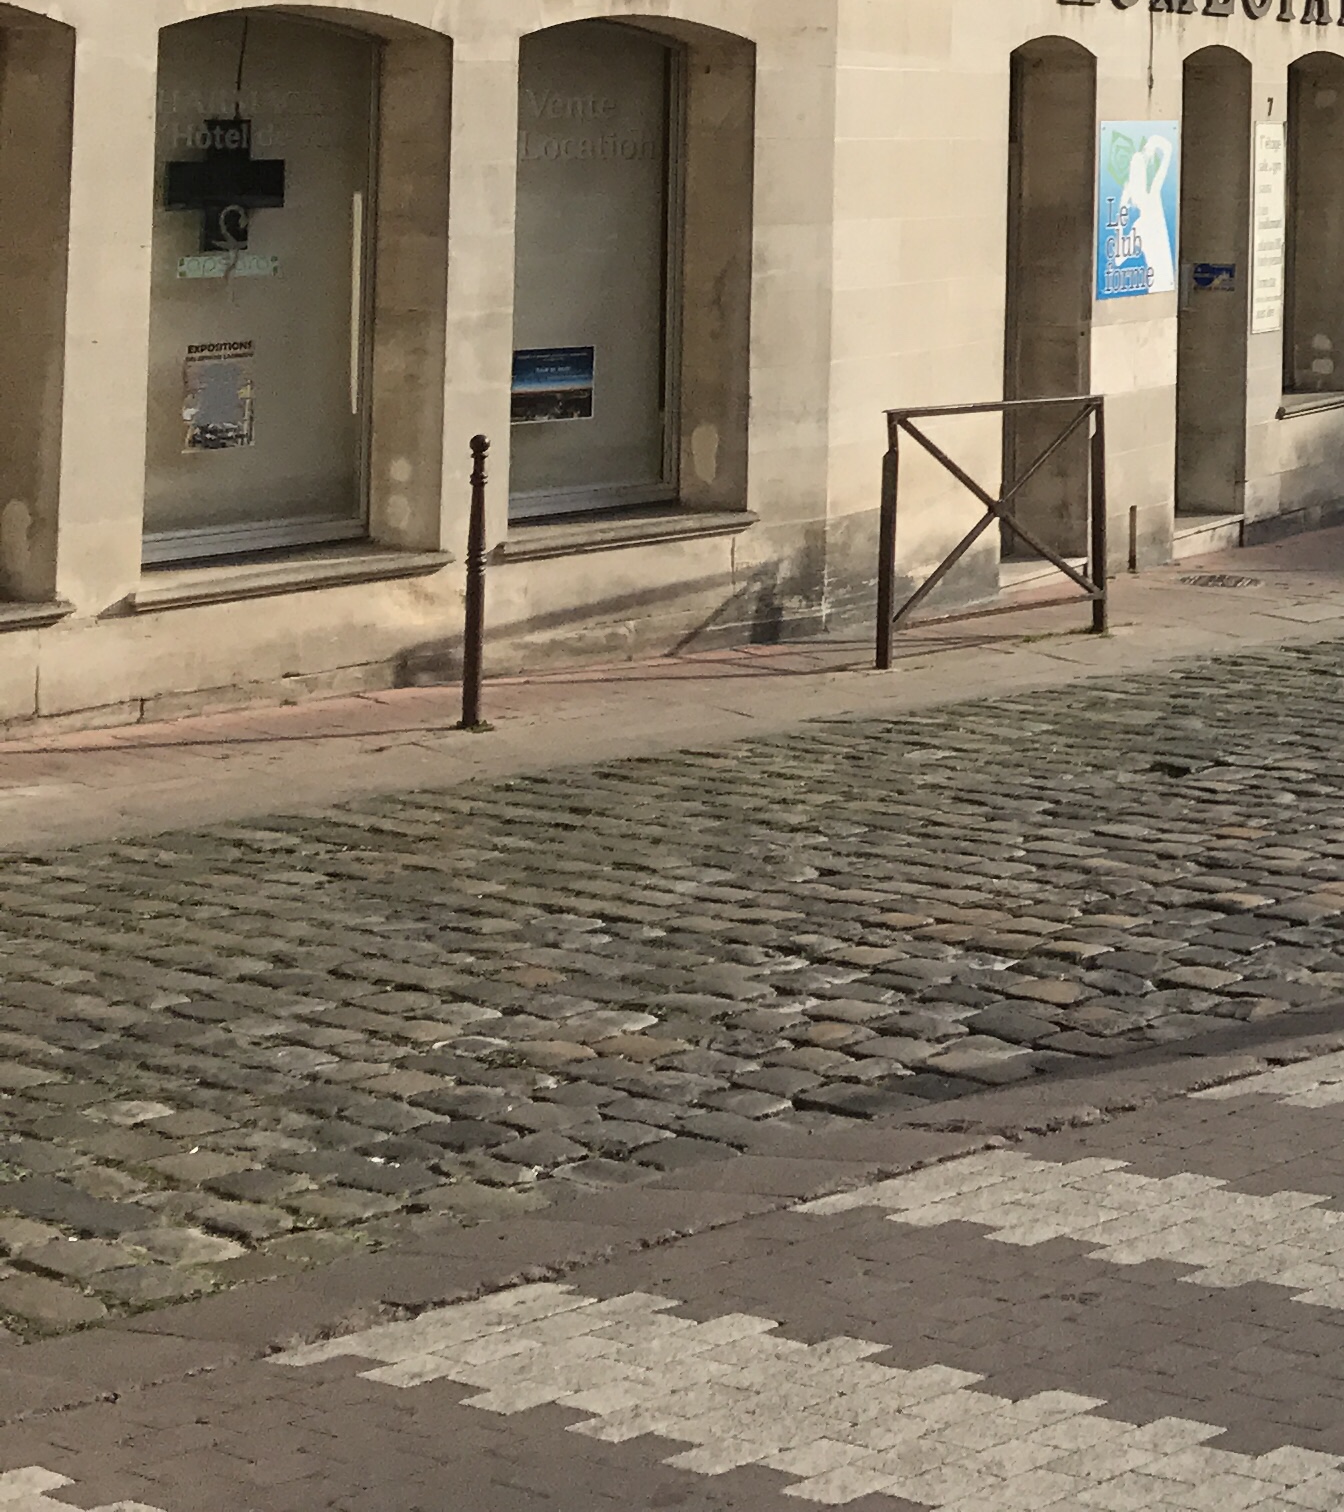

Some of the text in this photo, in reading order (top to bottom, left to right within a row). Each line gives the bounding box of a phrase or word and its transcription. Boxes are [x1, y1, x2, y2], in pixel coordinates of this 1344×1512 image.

[526, 88, 617, 120] Vente
[1266, 96, 1274, 117] 7
[519, 129, 656, 160] Location
[1106, 197, 1129, 227] Le
[1106, 227, 1142, 258] club
[1104, 260, 1155, 293] forme
[187, 340, 253, 355] EXPOSITIONS
